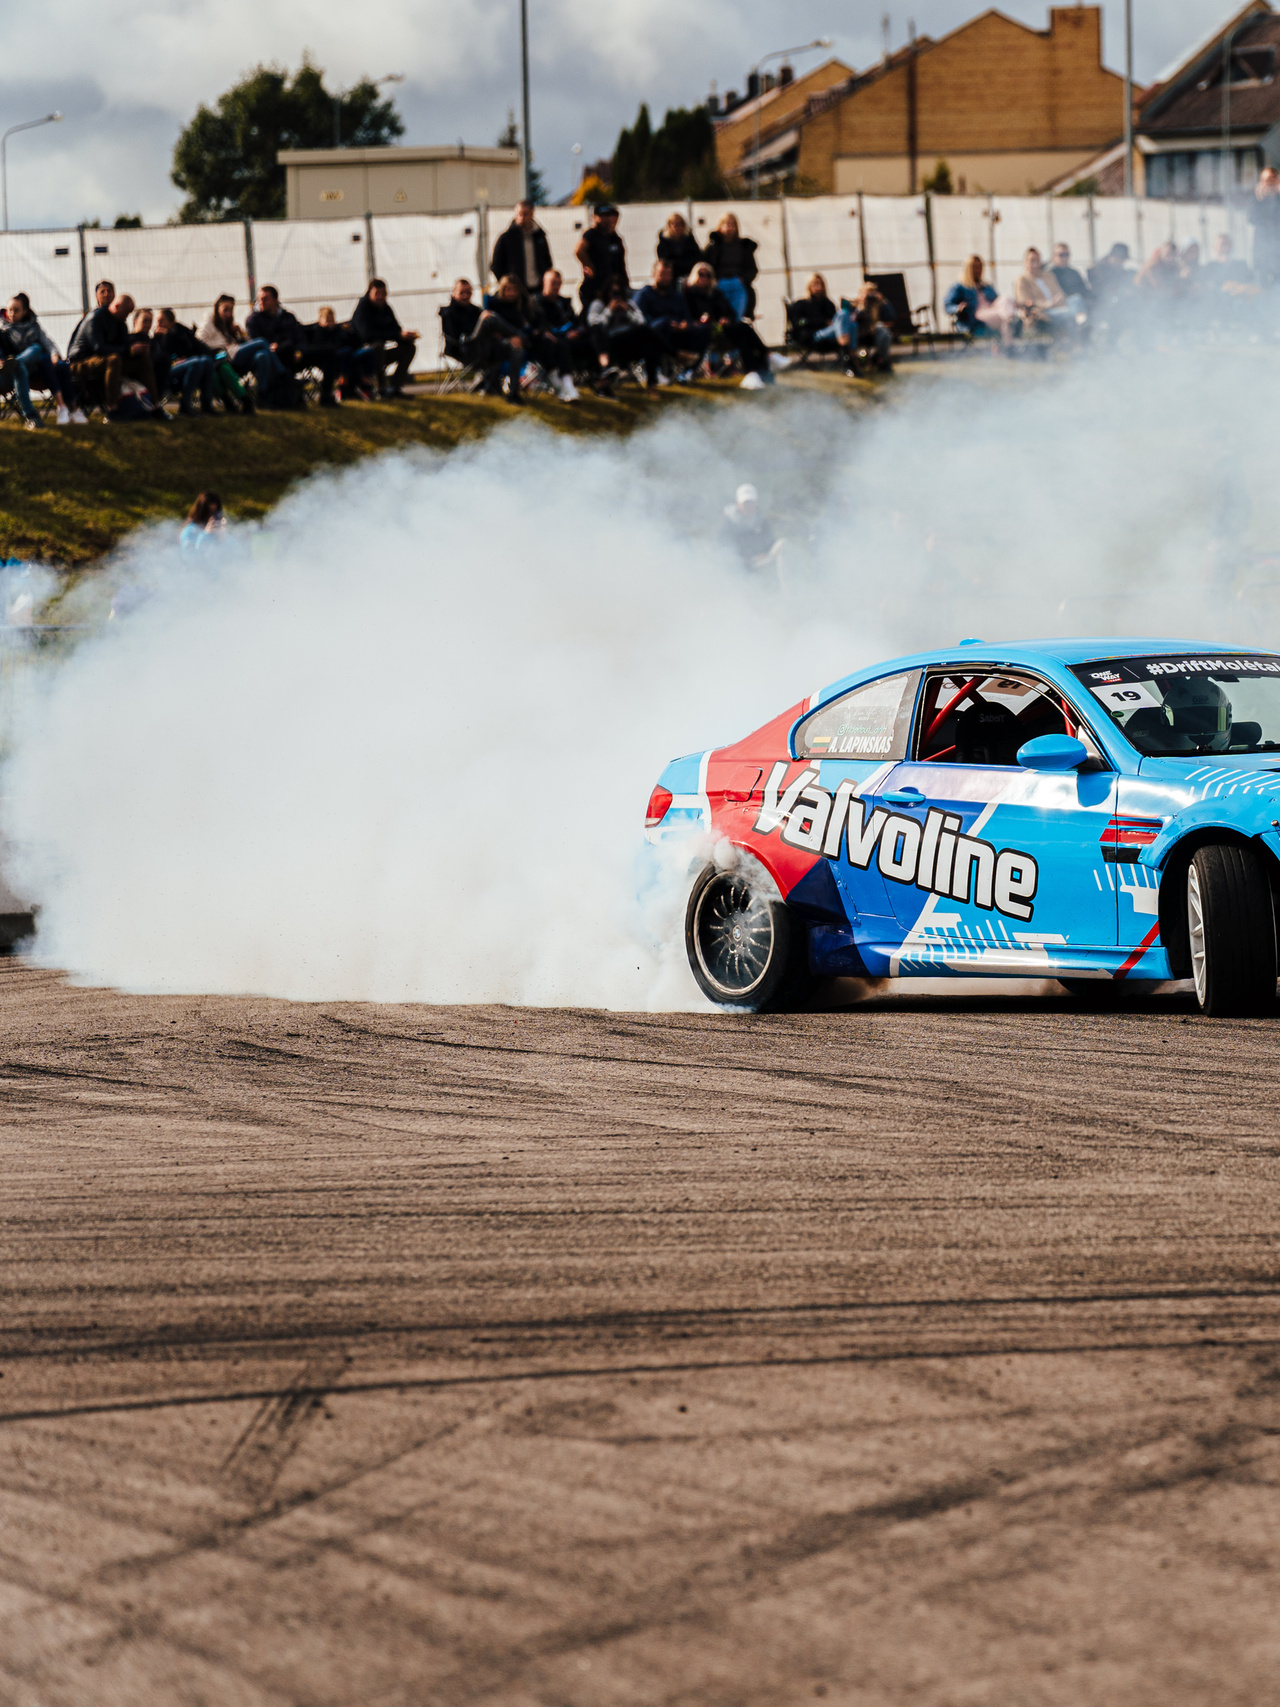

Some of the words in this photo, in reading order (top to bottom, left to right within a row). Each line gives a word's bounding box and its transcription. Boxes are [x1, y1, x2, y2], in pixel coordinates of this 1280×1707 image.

[1089, 670, 1111, 679] ONE
[1101, 673, 1120, 681] WAY
[1111, 691, 1141, 702] 19
[827, 736, 838, 753] A.
[839, 736, 894, 753] LAPINSKAS
[752, 761, 1038, 922] Valvoline
